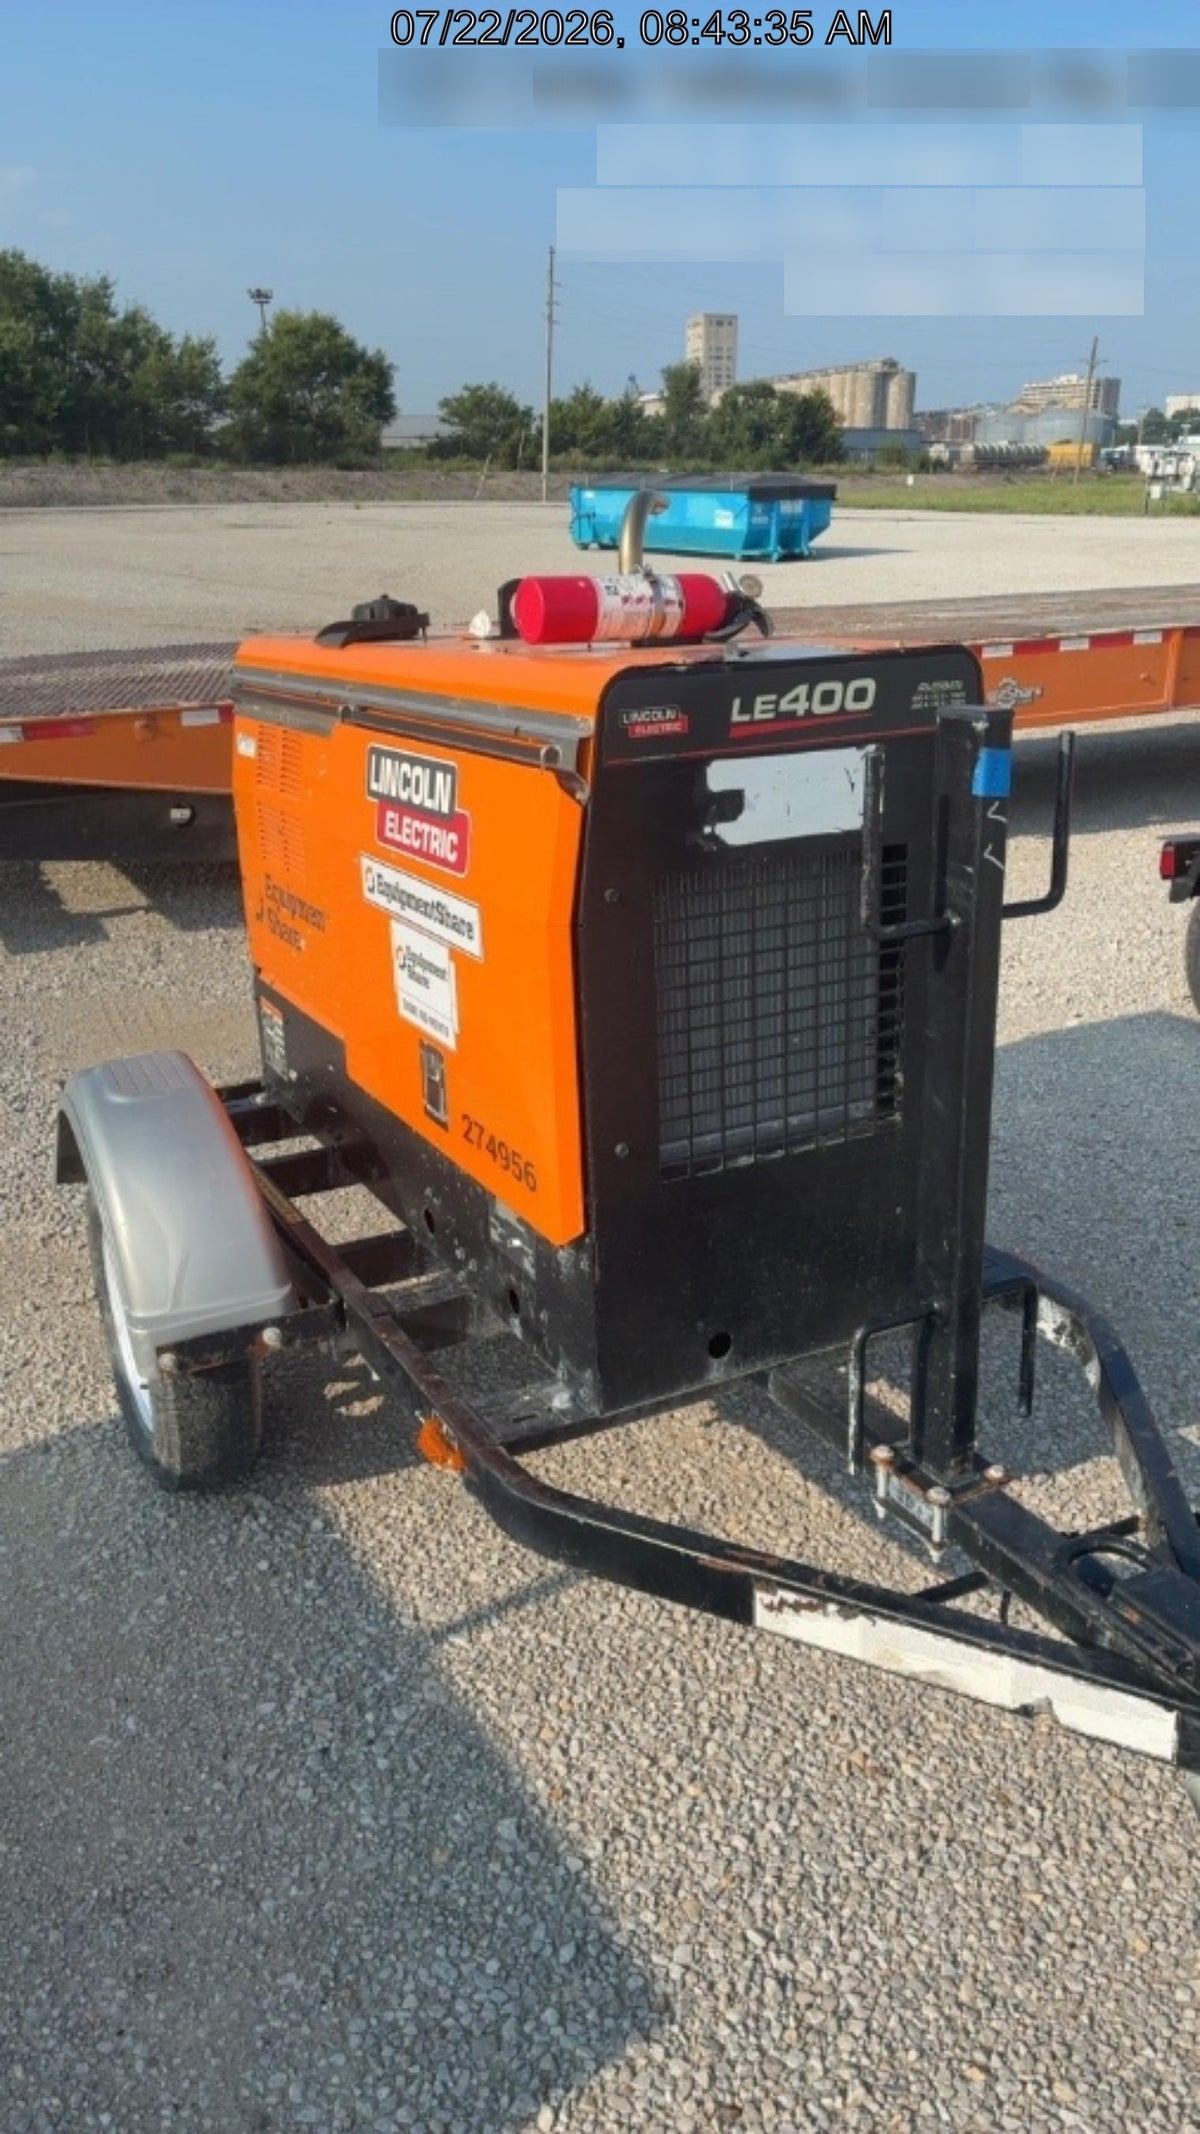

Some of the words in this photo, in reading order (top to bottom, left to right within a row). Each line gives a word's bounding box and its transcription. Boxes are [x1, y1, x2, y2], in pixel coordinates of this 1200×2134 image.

[622, 706, 678, 725] LINCOLN
[634, 720, 683, 734] ELECTRIC
[730, 677, 876, 723] LE400
[369, 753, 452, 814] LINCOLN
[383, 810, 459, 864] ELECTRIC
[376, 872, 475, 941] EquipmentShare
[462, 1112, 537, 1193] 274956
